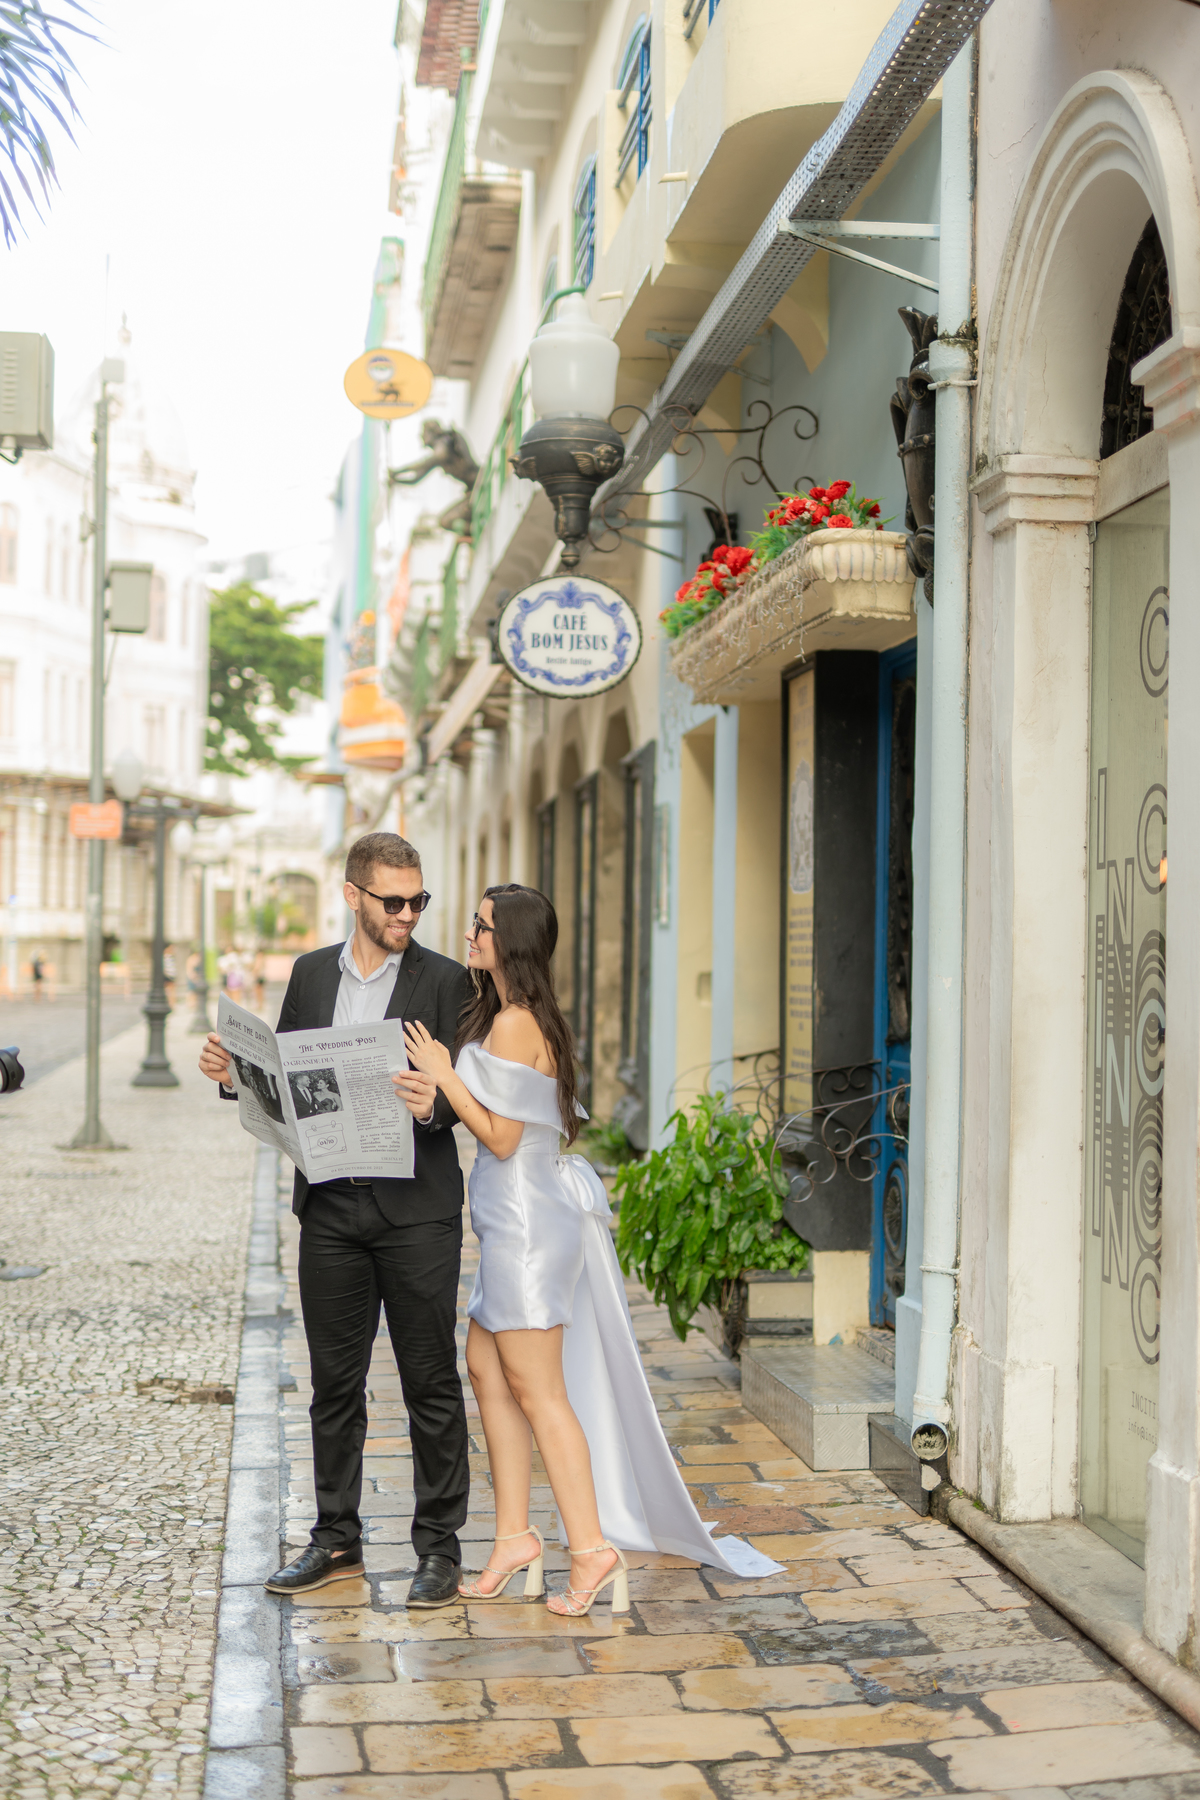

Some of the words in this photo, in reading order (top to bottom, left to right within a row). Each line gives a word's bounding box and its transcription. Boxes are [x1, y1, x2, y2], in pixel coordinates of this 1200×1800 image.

[553, 612, 587, 630] CAFÉ
[531, 633, 563, 648] BOM
[569, 635, 608, 651] JESUS
[226, 1015, 242, 1030] SAVE
[243, 1025, 253, 1036] THE
[255, 1031, 268, 1044] DATE
[298, 1044, 314, 1053] THE
[316, 1040, 353, 1051] WEDDING
[355, 1037, 377, 1046] POST
[1128, 1418, 1157, 1446] info@inci
